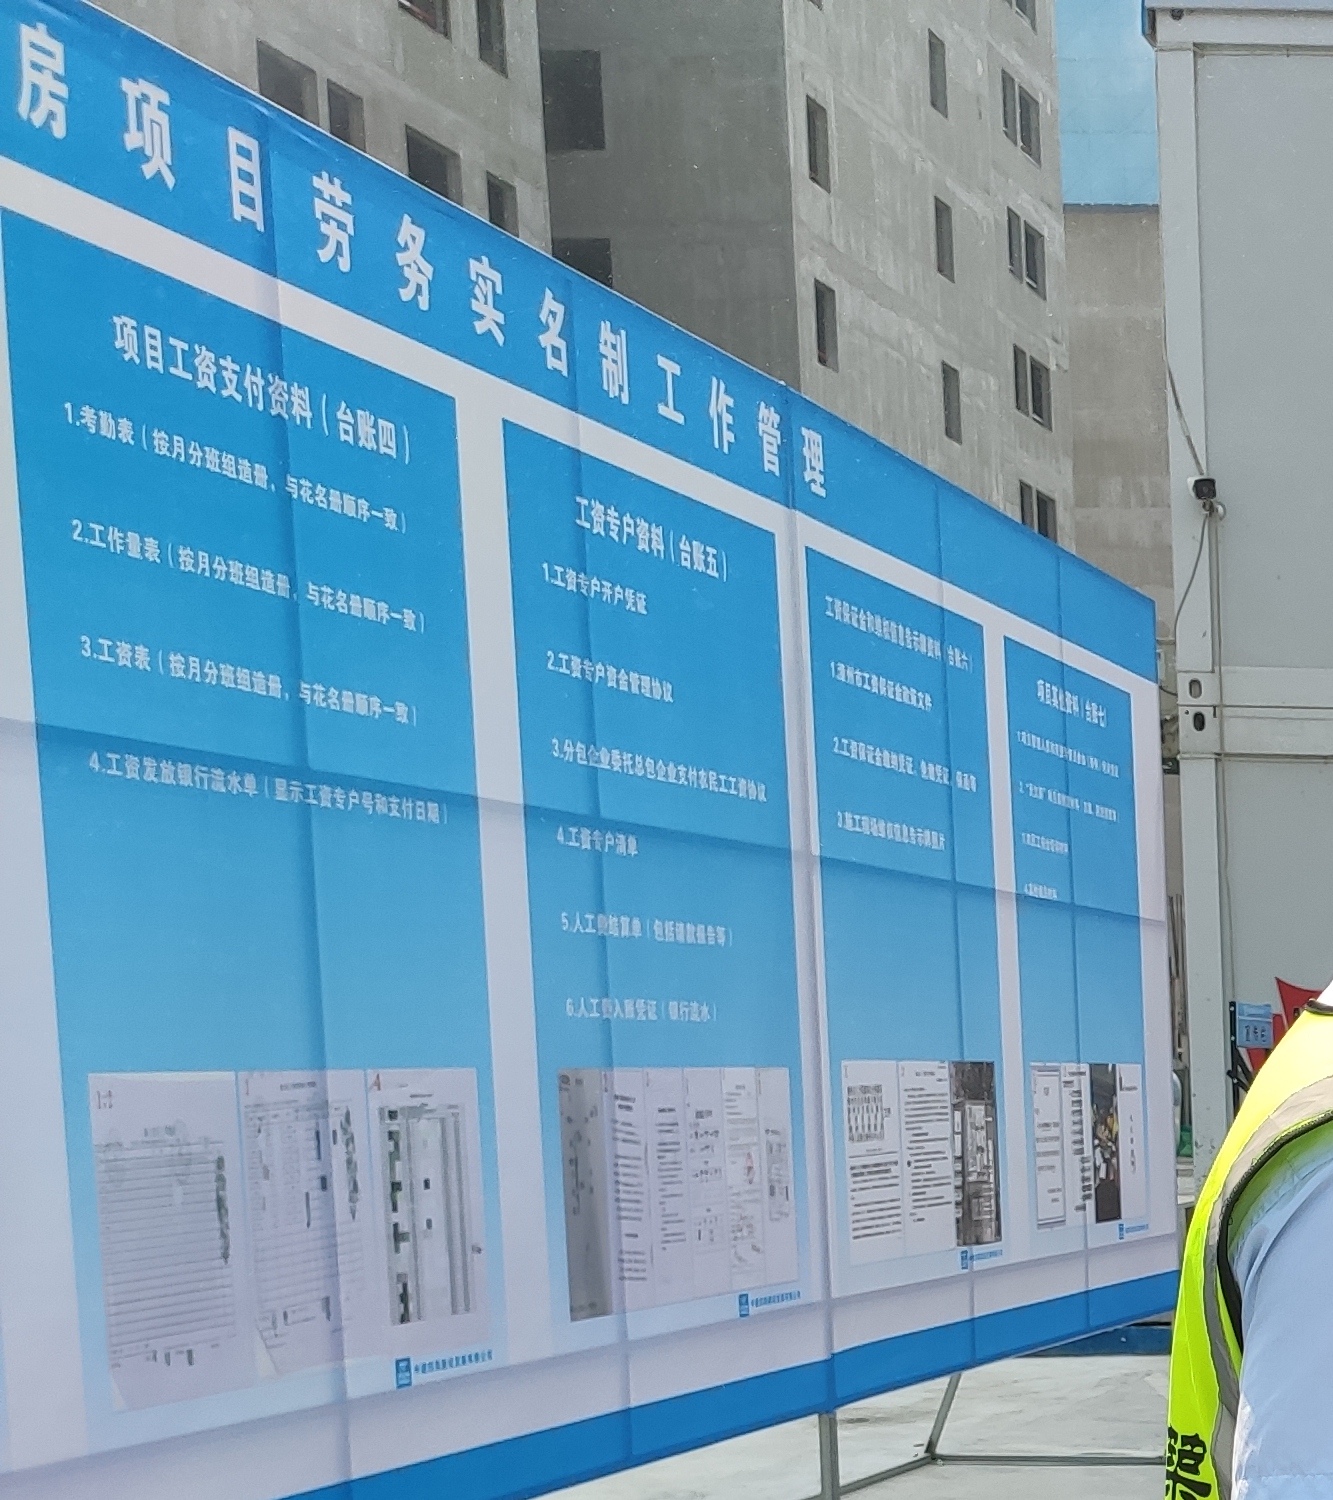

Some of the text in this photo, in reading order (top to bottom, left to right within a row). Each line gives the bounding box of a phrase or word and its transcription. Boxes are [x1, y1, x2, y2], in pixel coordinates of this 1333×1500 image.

[18, 22, 826, 497] 房项目劳务实名制工作管理
